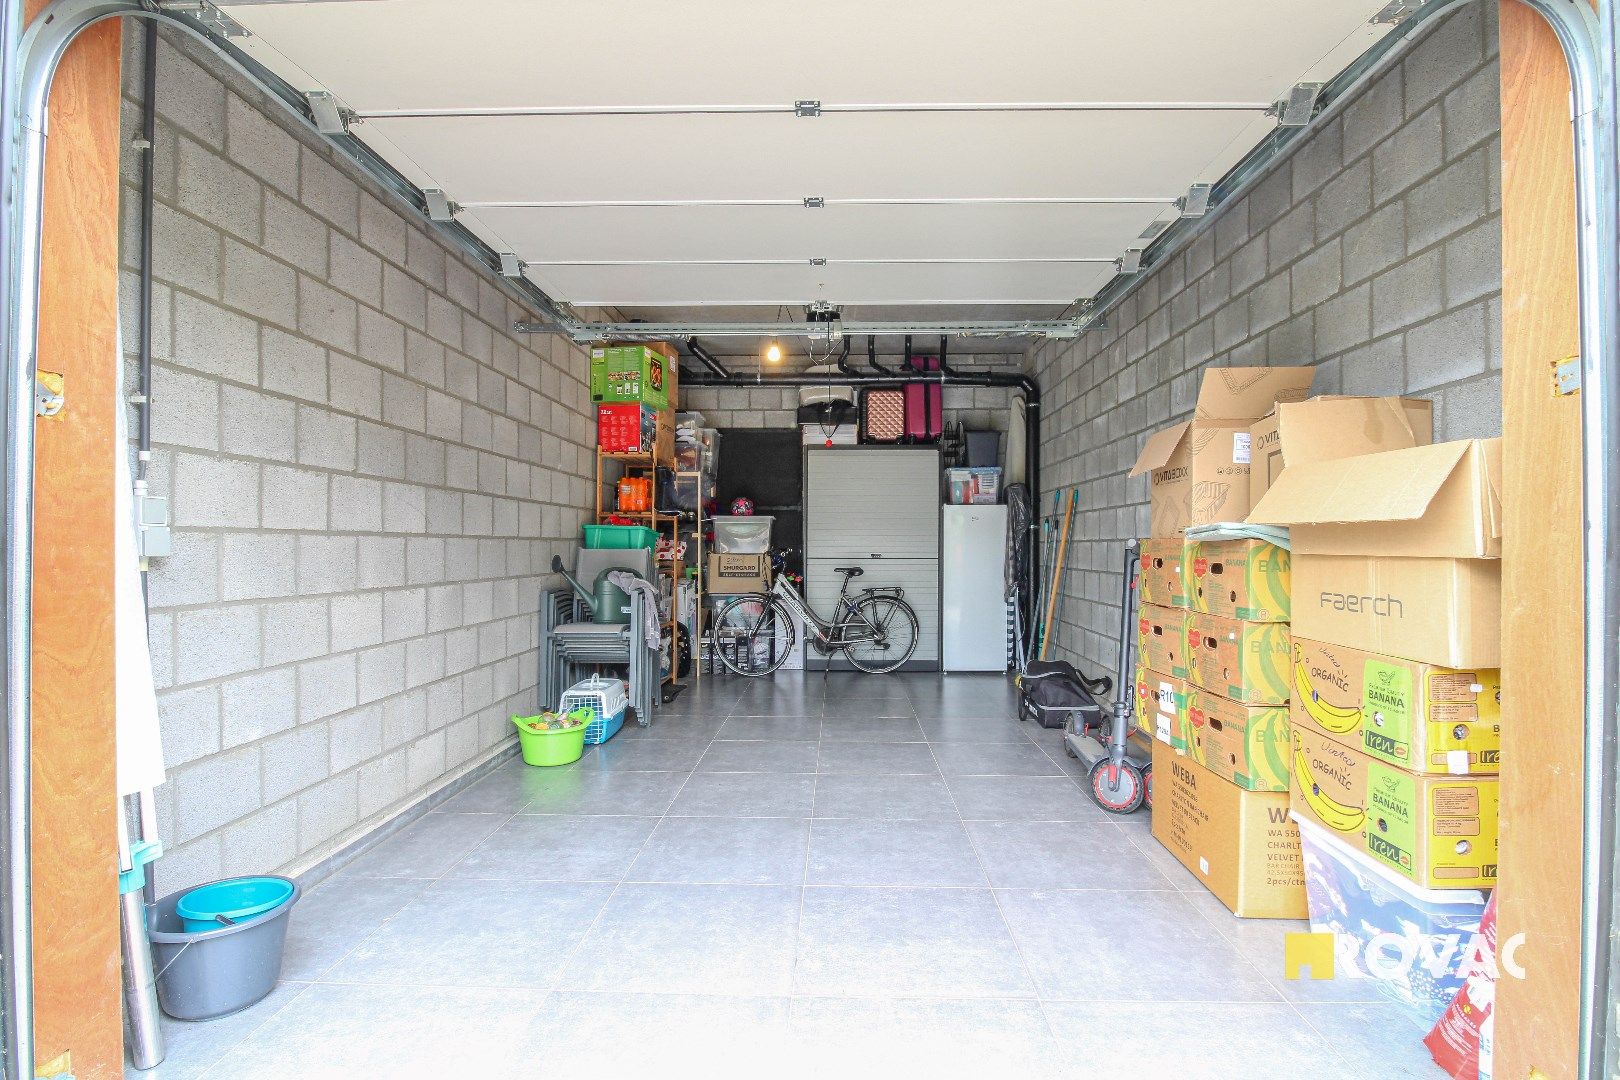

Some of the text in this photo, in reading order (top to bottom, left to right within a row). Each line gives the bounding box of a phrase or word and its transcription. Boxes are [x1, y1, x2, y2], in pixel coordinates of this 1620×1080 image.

[1320, 591, 1403, 619] Faerch
[1311, 667, 1349, 692] ORGANIC
[1368, 689, 1406, 708] BANANA
[1171, 760, 1197, 790] WEBA
[1312, 758, 1352, 791] ORGANIC
[1372, 792, 1409, 818] BANANA
[1268, 807, 1298, 824] W
[1267, 829, 1283, 837] WA
[1267, 841, 1301, 850] CHARLT
[1267, 853, 1300, 862] VELVET
[1267, 877, 1306, 886] 2pcs/ctn
